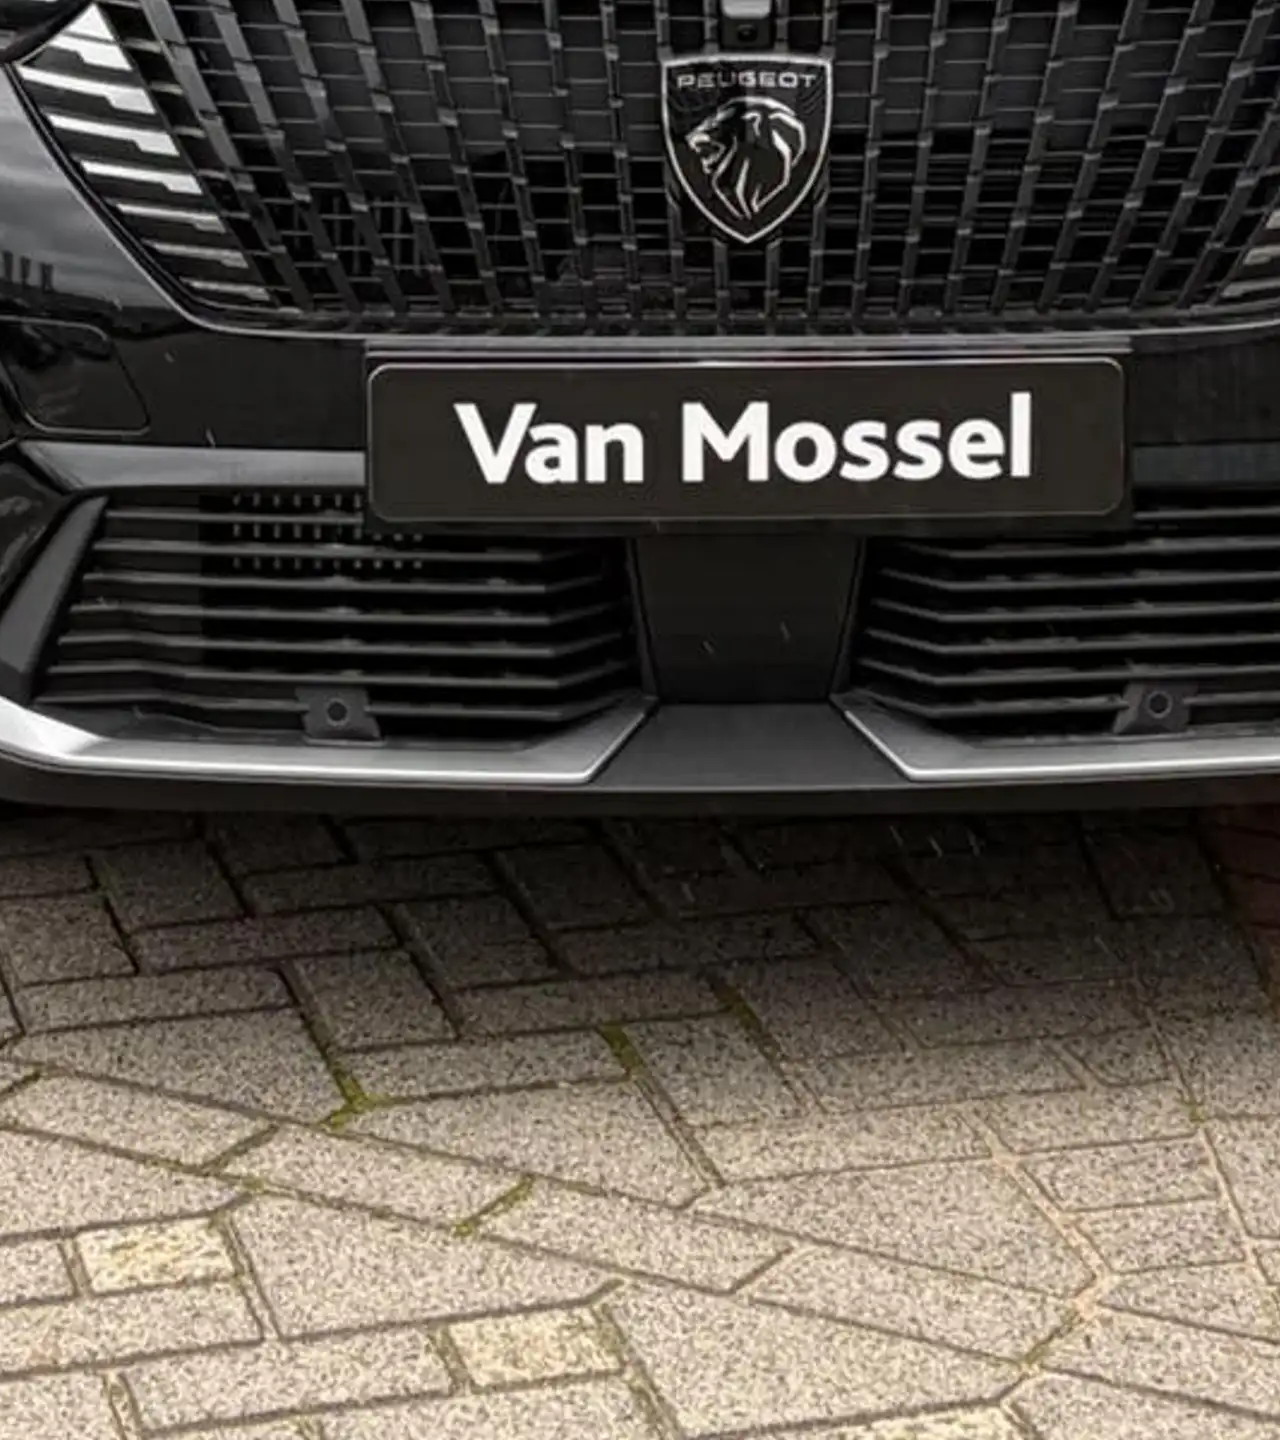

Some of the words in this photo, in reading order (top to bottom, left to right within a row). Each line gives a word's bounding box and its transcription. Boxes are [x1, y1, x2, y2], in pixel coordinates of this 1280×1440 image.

[677, 71, 817, 91] PEUGEOT
[454, 401, 644, 484] Van
[682, 391, 1032, 484] Mossel
